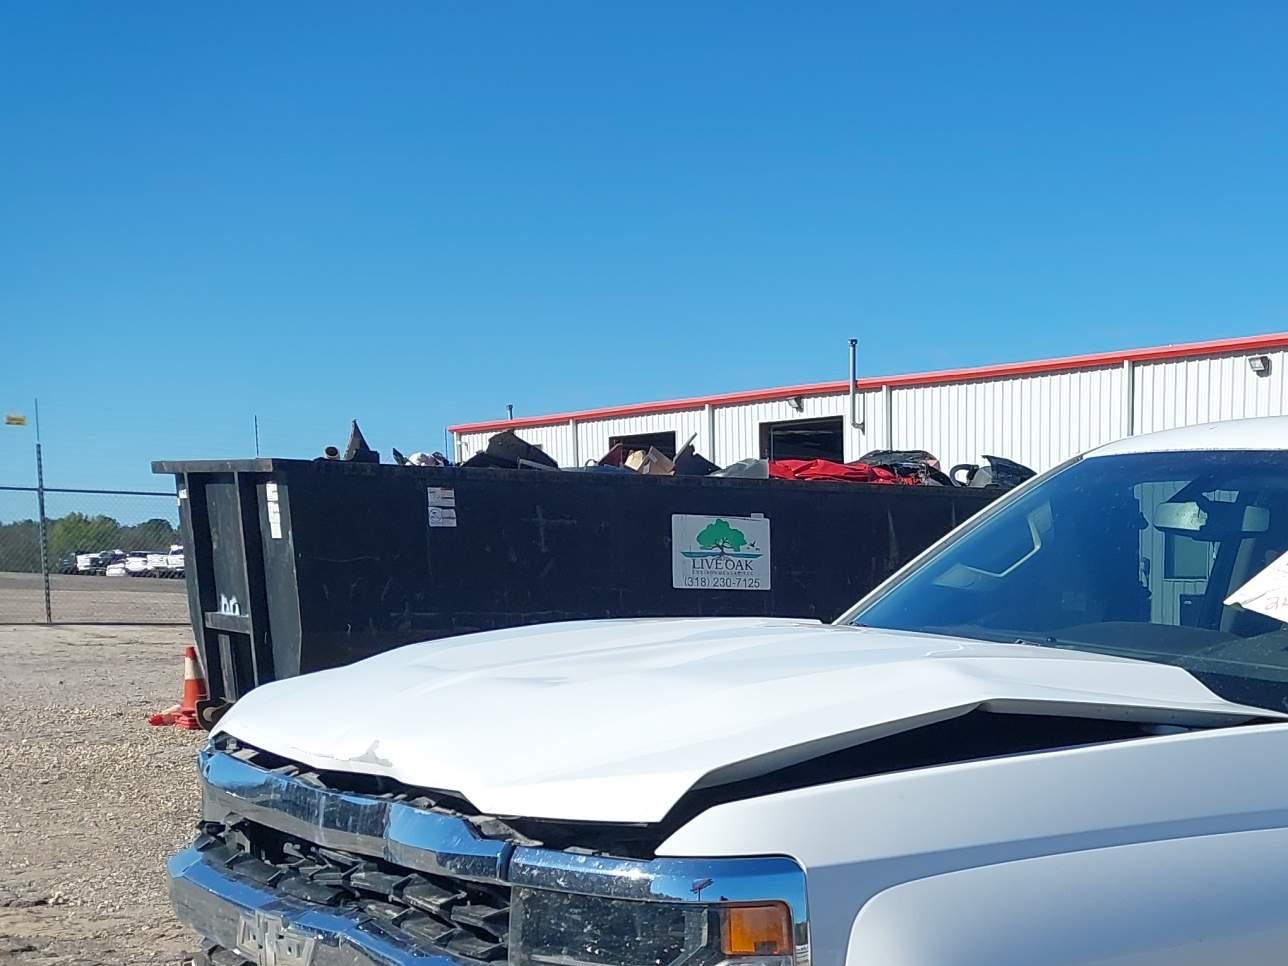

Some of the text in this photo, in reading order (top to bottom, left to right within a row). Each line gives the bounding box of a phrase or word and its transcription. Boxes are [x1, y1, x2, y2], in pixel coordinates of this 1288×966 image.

[692, 558, 754, 571] LIVE OAK
[684, 576, 760, 589] (318) 230-7125
